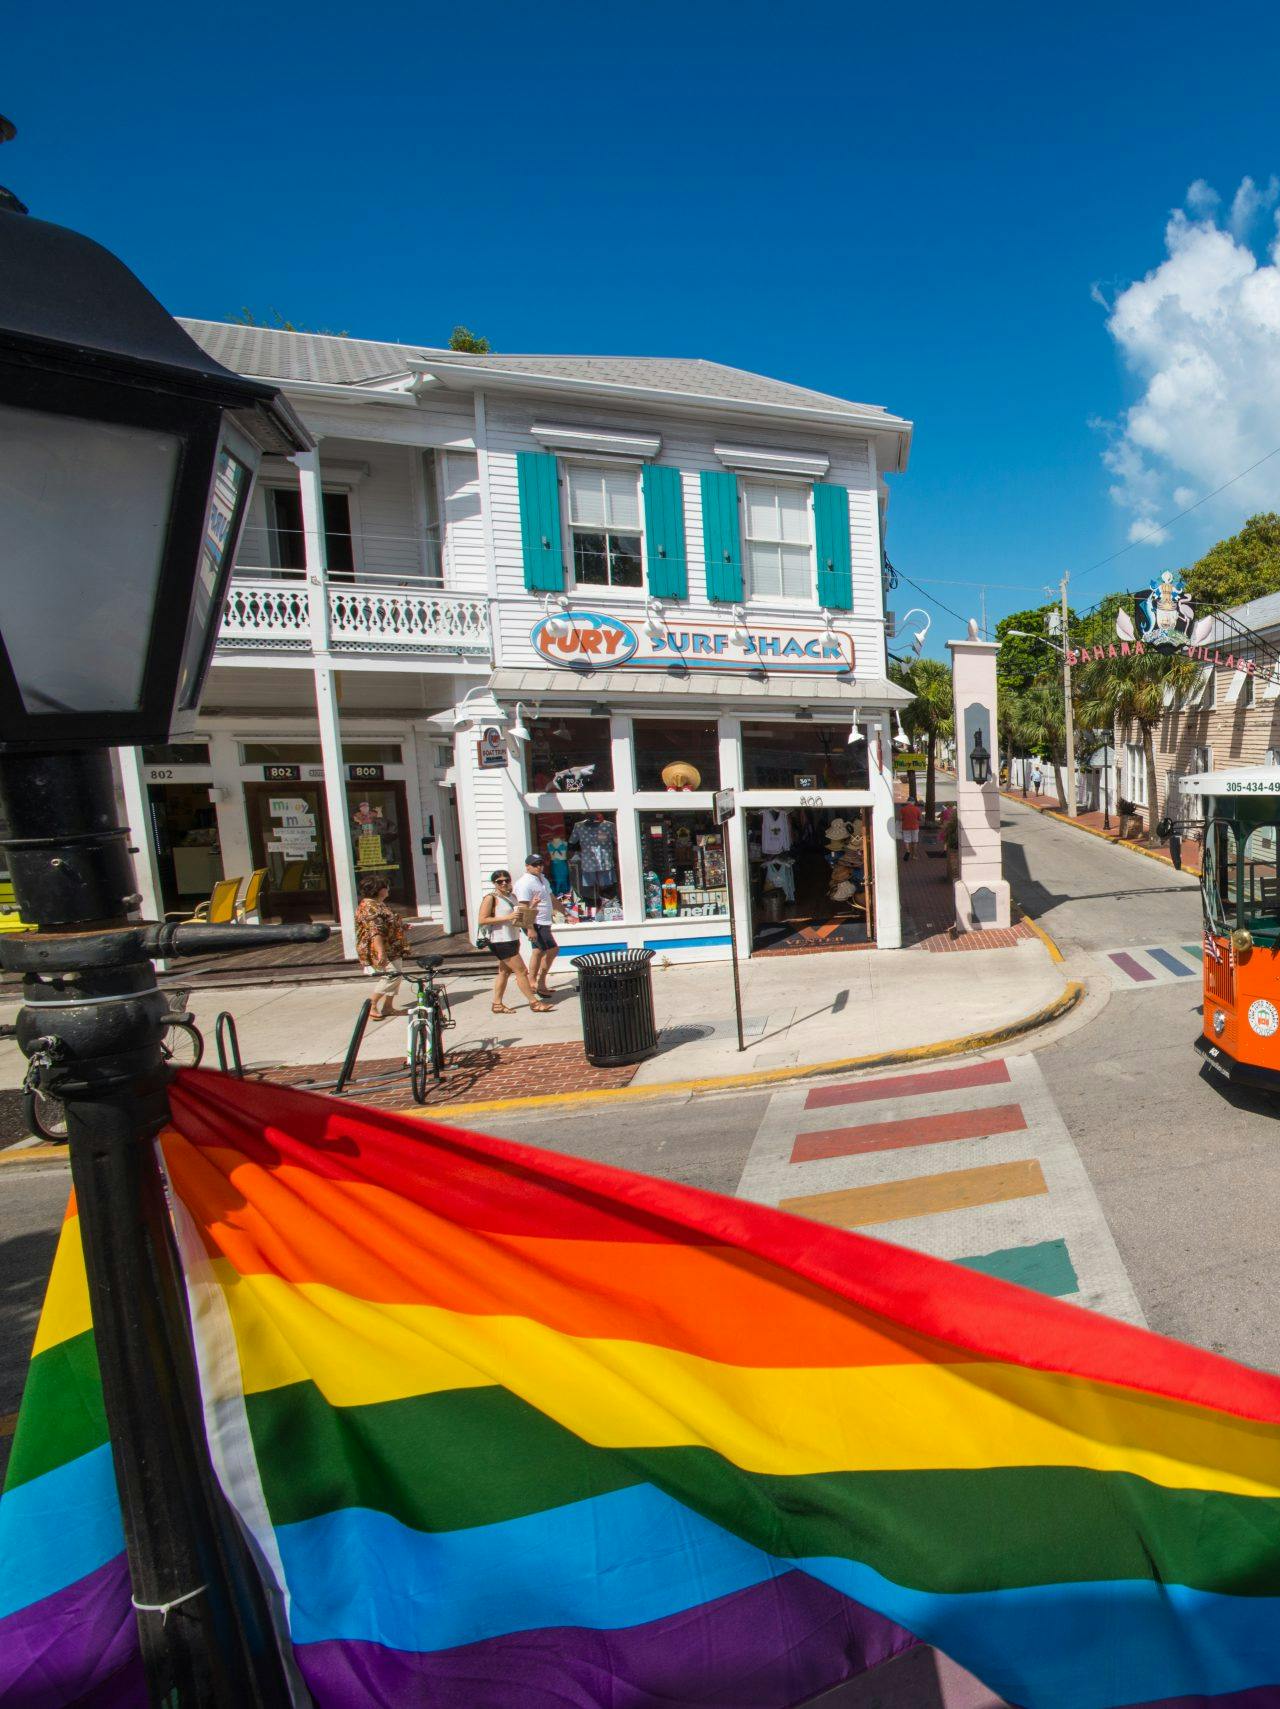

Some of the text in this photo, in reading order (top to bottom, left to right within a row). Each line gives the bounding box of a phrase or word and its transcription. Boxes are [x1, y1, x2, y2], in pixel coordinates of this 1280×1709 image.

[540, 626, 843, 660] FURY SURF SHACK
[1066, 641, 1257, 676] BAHAMA VILLAGE
[150, 770, 173, 779] 802
[271, 768, 292, 777] 802
[356, 767, 376, 776] 800
[681, 903, 716, 918] neff
